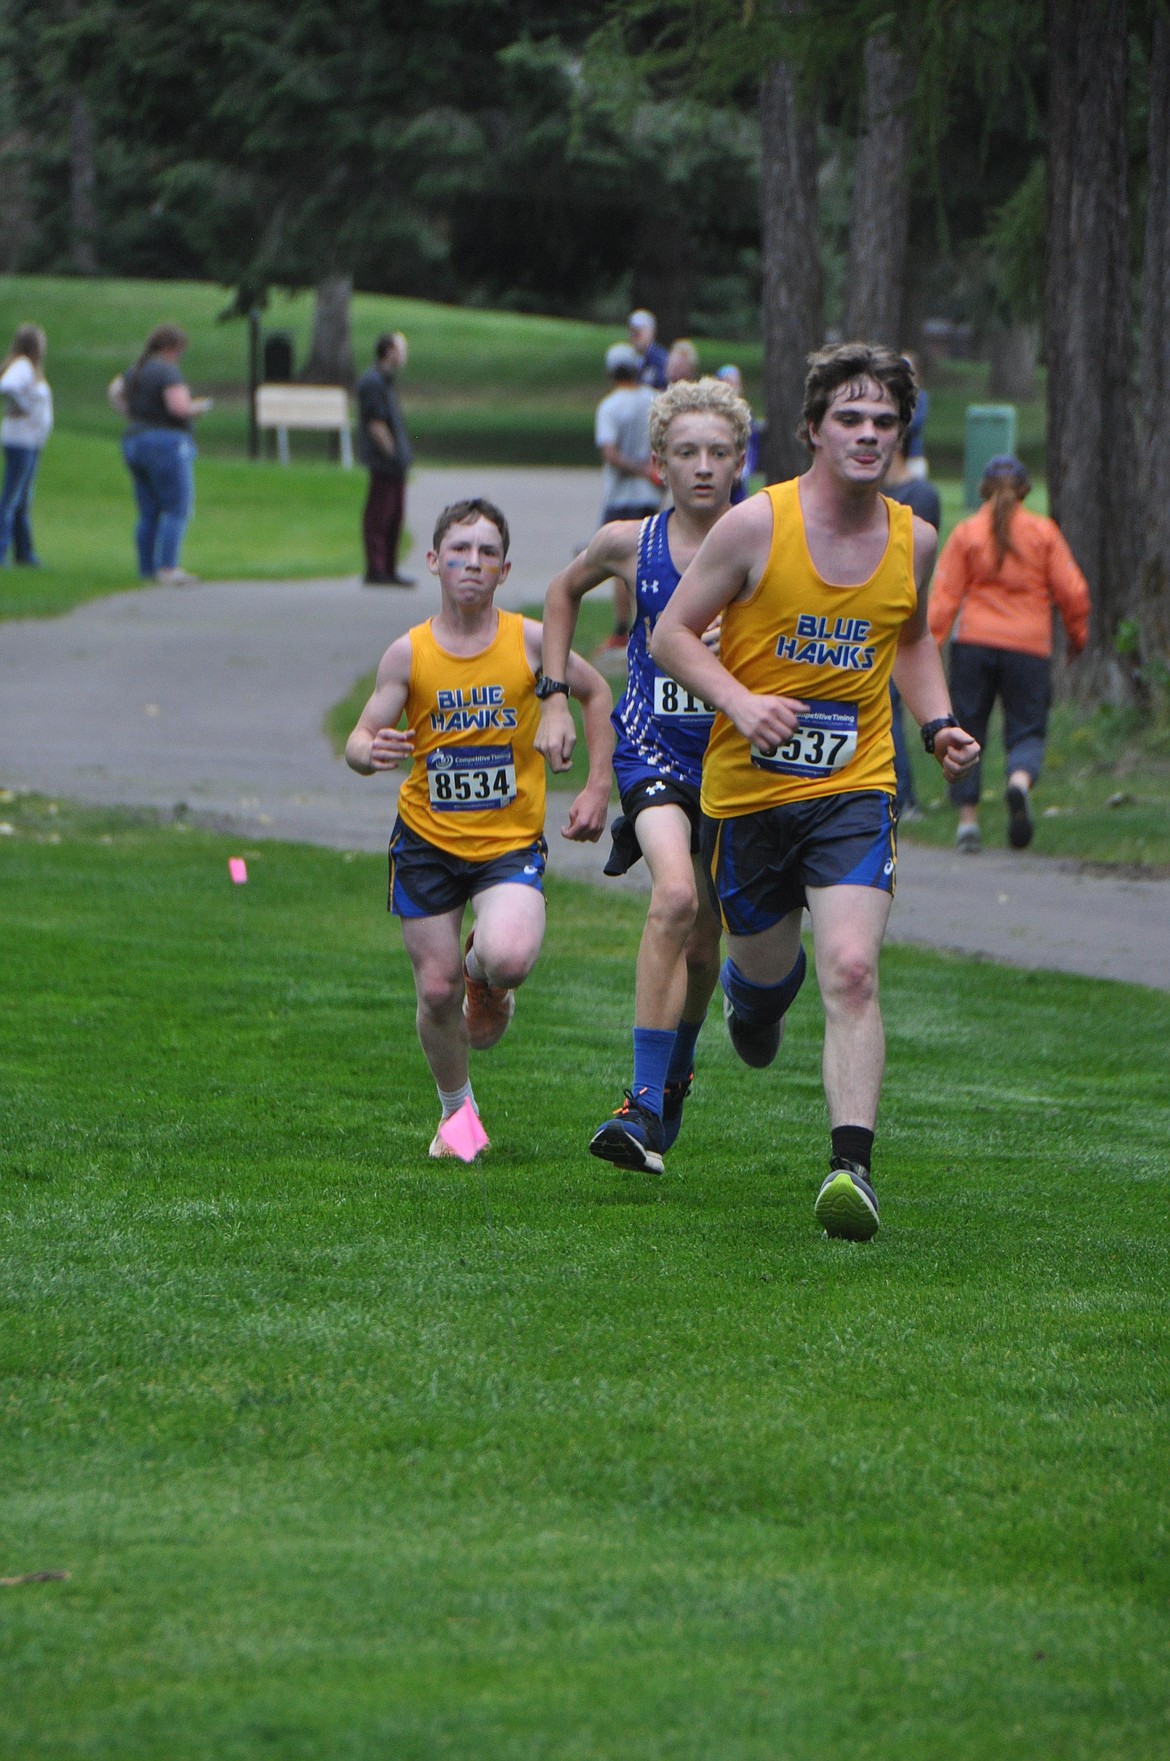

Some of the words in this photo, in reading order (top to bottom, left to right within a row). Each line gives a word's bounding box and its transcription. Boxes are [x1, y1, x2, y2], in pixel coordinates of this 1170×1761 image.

[796, 613, 872, 643] BLUE
[775, 635, 876, 670] HAWKS
[437, 685, 505, 710] BLUE
[662, 681, 716, 712] 81
[430, 708, 517, 732] HAWKS
[795, 712, 832, 720] ompetitive
[832, 713, 855, 722] Timing
[435, 769, 510, 800] 8534
